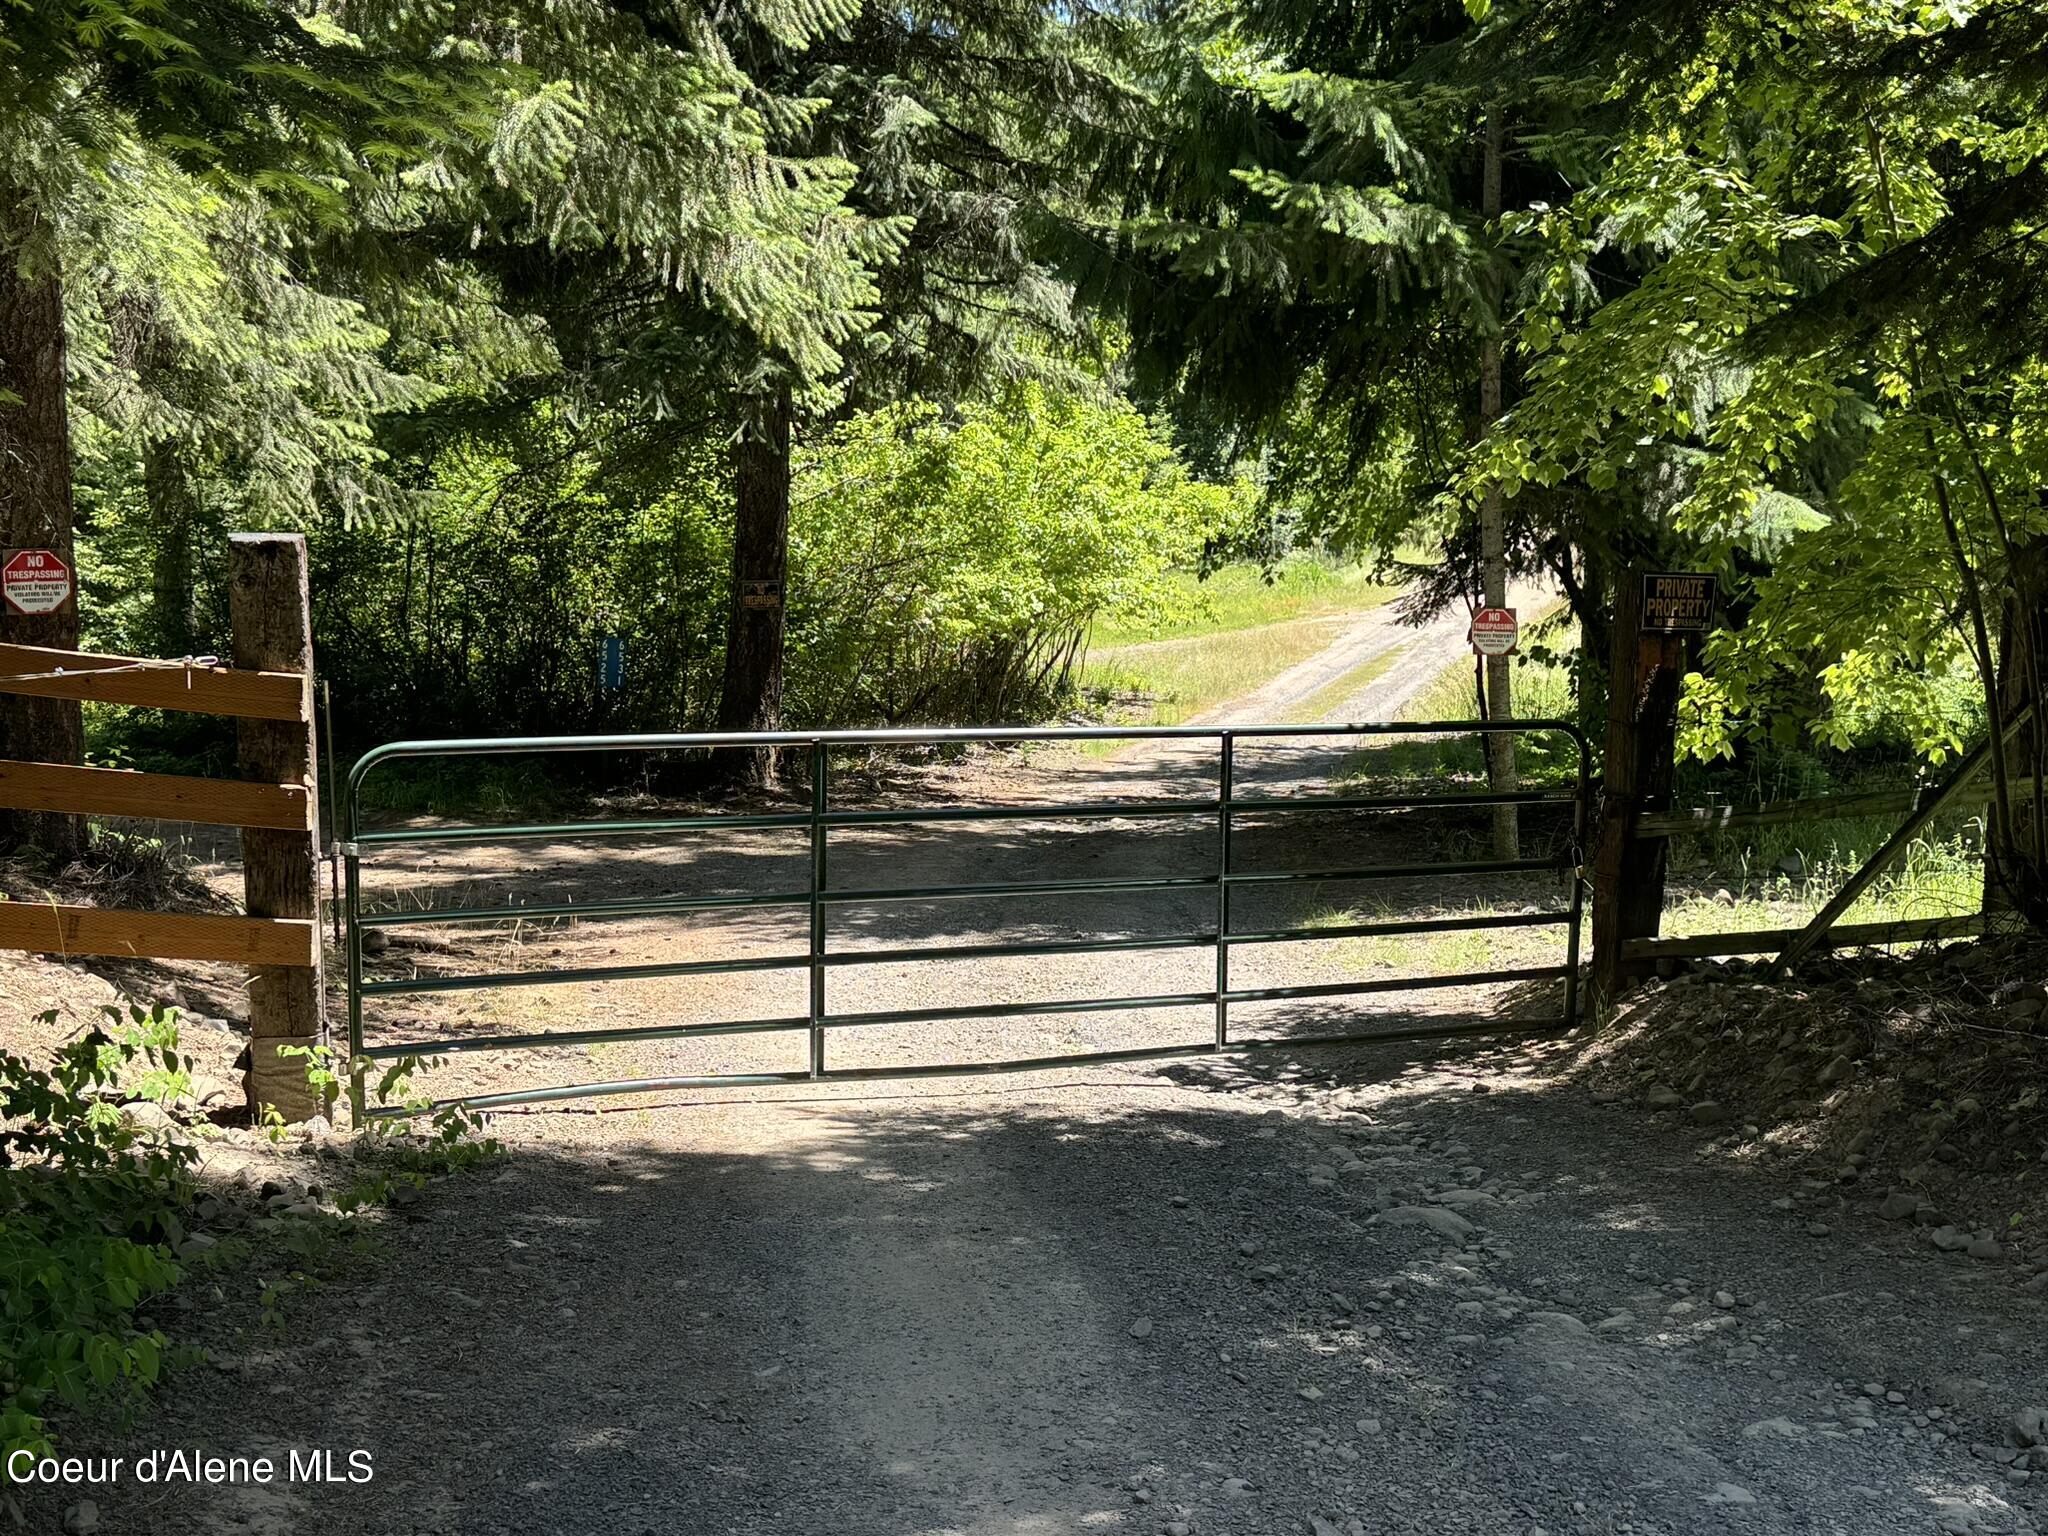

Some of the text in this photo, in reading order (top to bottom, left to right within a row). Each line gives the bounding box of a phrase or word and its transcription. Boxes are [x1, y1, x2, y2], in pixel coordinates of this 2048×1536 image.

[27, 555, 44, 567] NO
[7, 569, 65, 579] TRESPASSING
[6, 584, 32, 592] PRIVATE
[1656, 578, 1706, 598] PRIVATE
[1646, 598, 1711, 618] PROPERTY
[1488, 612, 1500, 622] NO
[600, 639, 608, 685] 6525
[617, 640, 625, 686] 6531
